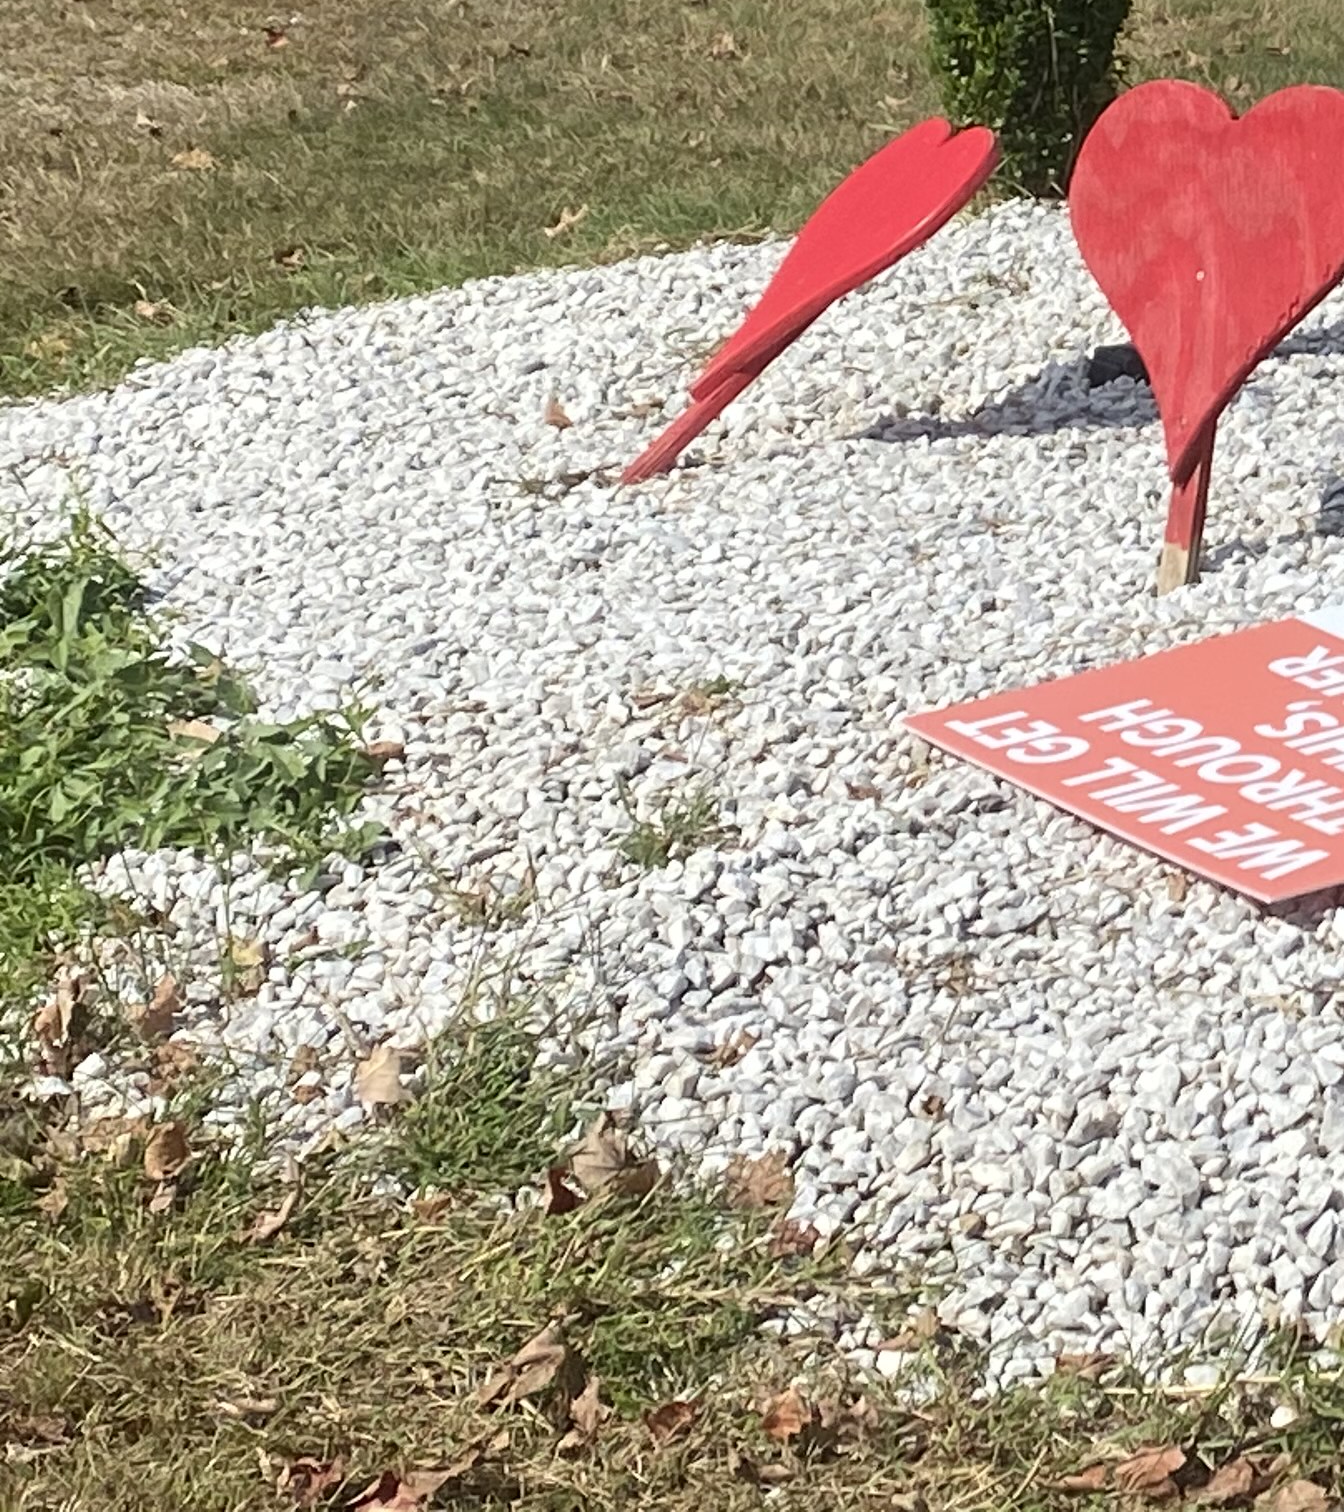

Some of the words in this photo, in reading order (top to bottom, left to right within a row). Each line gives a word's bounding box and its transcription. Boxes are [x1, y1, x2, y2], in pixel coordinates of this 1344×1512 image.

[944, 710, 1091, 765] GET
[1062, 756, 1208, 835] WILL
[1186, 824, 1330, 881] WE
